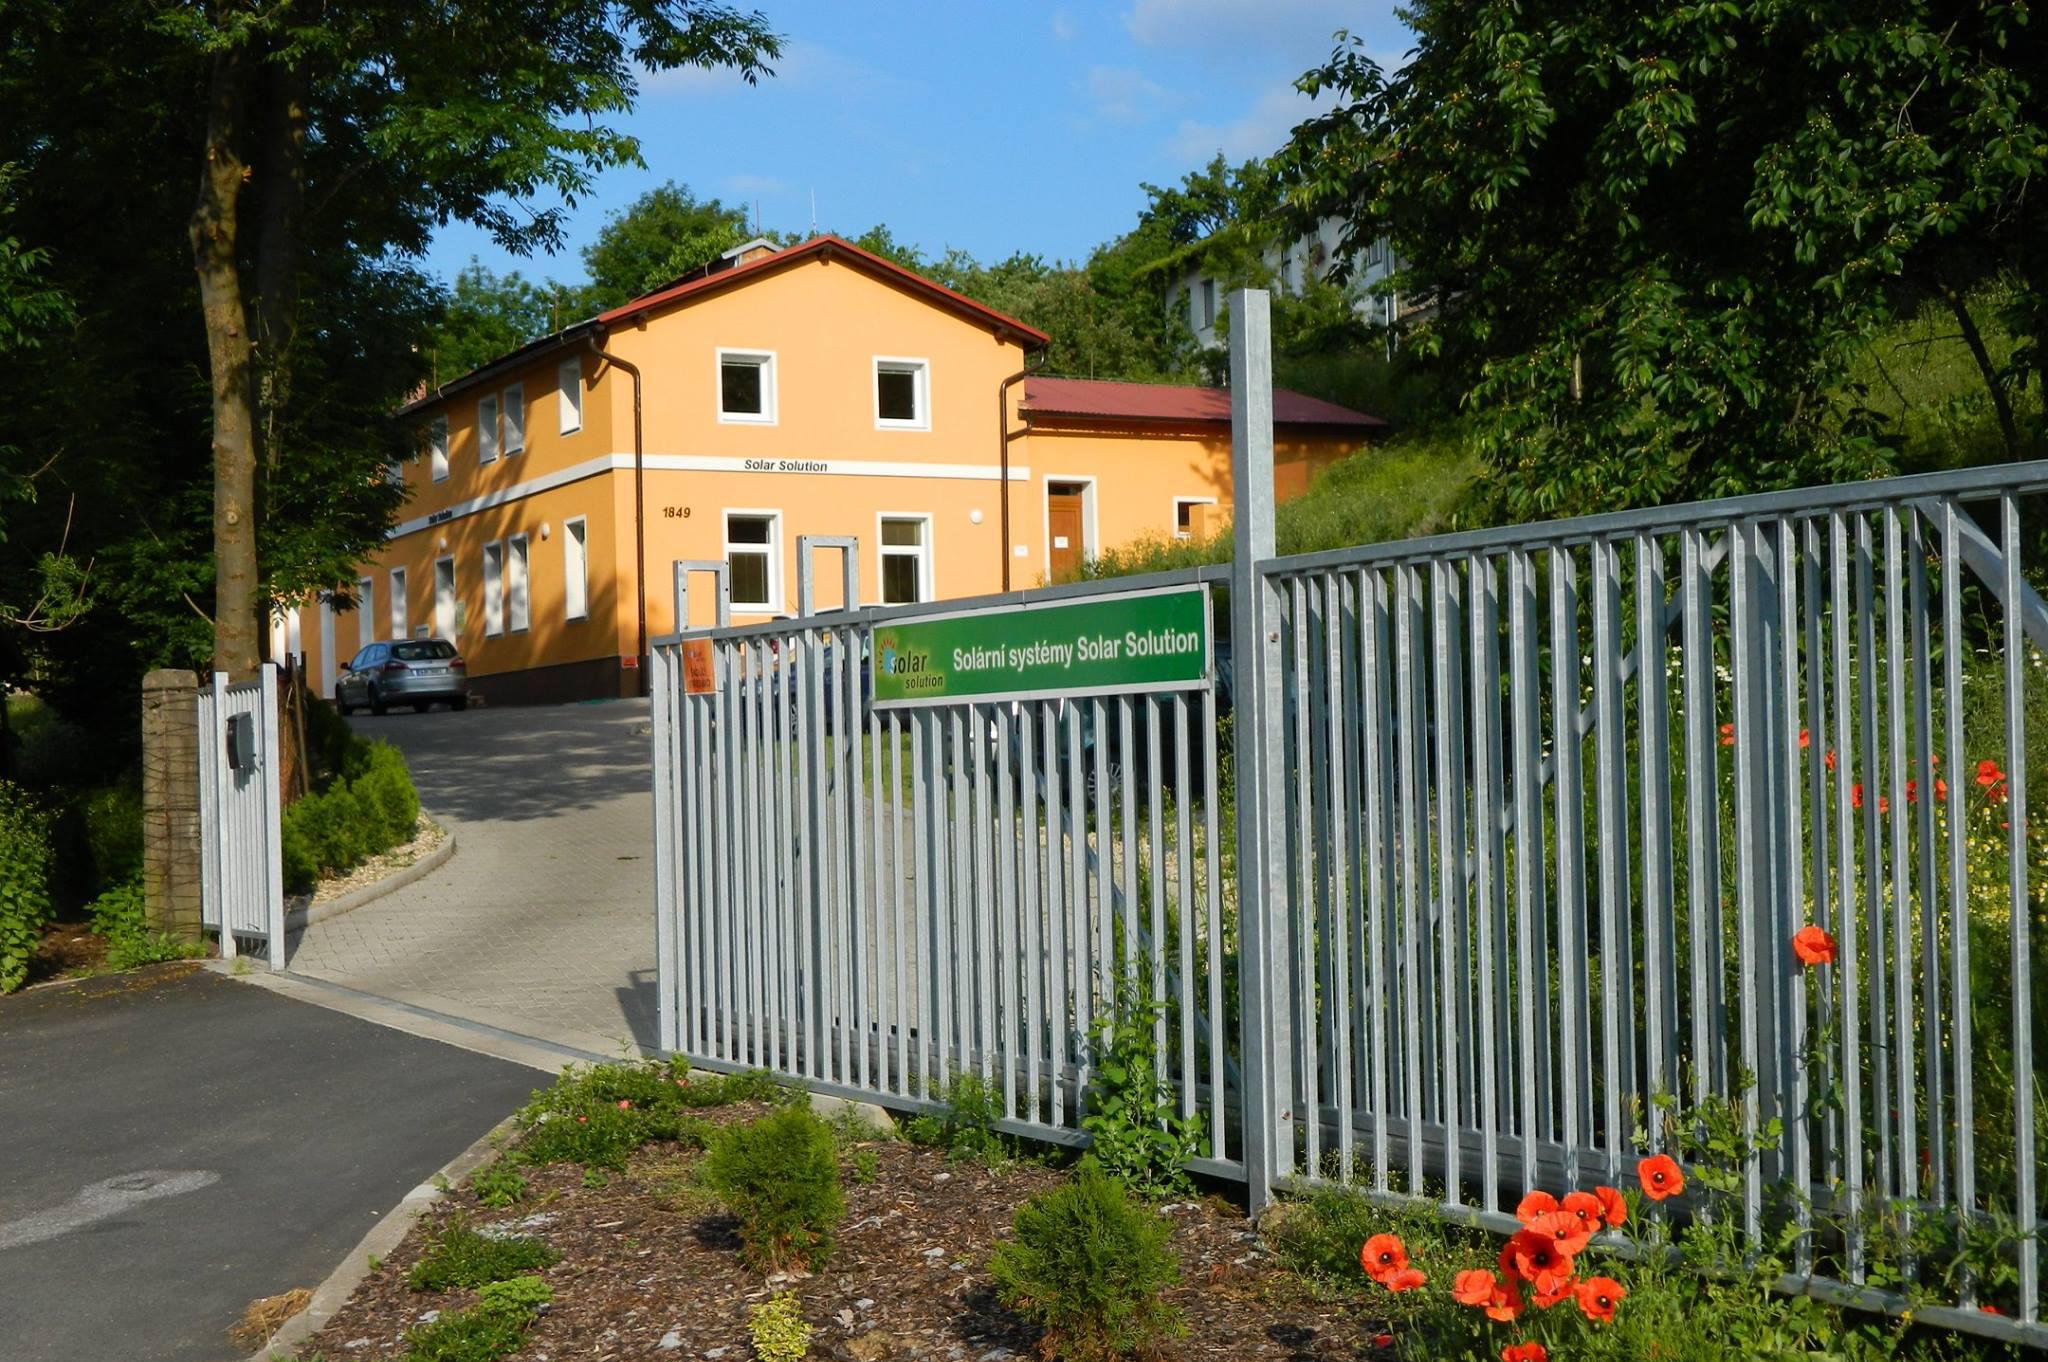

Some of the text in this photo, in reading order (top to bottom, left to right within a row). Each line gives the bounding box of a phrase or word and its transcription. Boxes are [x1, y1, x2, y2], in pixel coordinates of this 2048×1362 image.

[744, 459, 828, 472] Solar Solution
[662, 507, 691, 518] 1849
[953, 628, 1199, 672] Solární systémy Solar Solution
[890, 650, 928, 675] solar
[905, 674, 944, 689] solution
